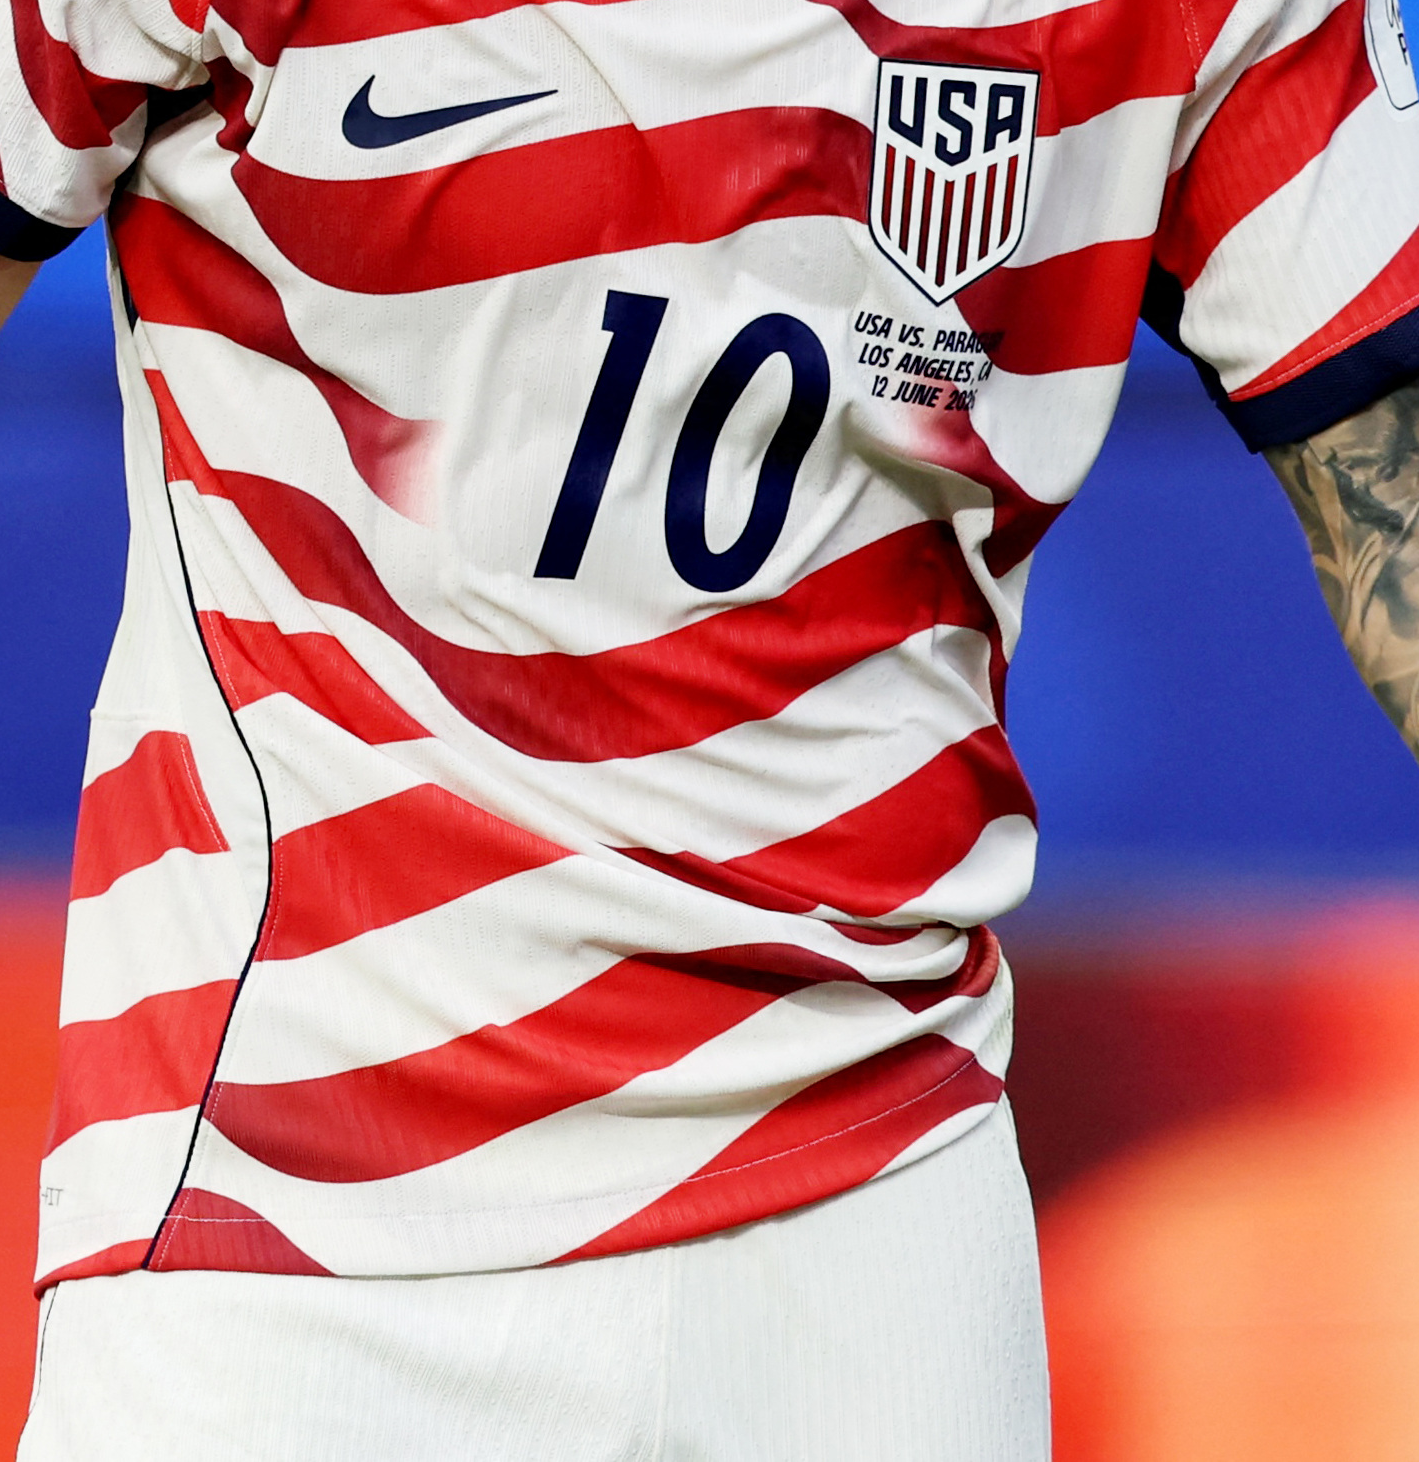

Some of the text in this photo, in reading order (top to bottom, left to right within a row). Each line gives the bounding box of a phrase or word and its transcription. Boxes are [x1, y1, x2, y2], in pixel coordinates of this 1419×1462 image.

[888, 75, 1026, 167] USA
[854, 311, 893, 339] USA
[898, 324, 924, 348] VS.
[858, 343, 894, 368] LOS
[895, 353, 974, 386] ANGELES,
[871, 375, 888, 398] 12
[891, 380, 943, 408] JUNE
[533, 289, 831, 593] 10
